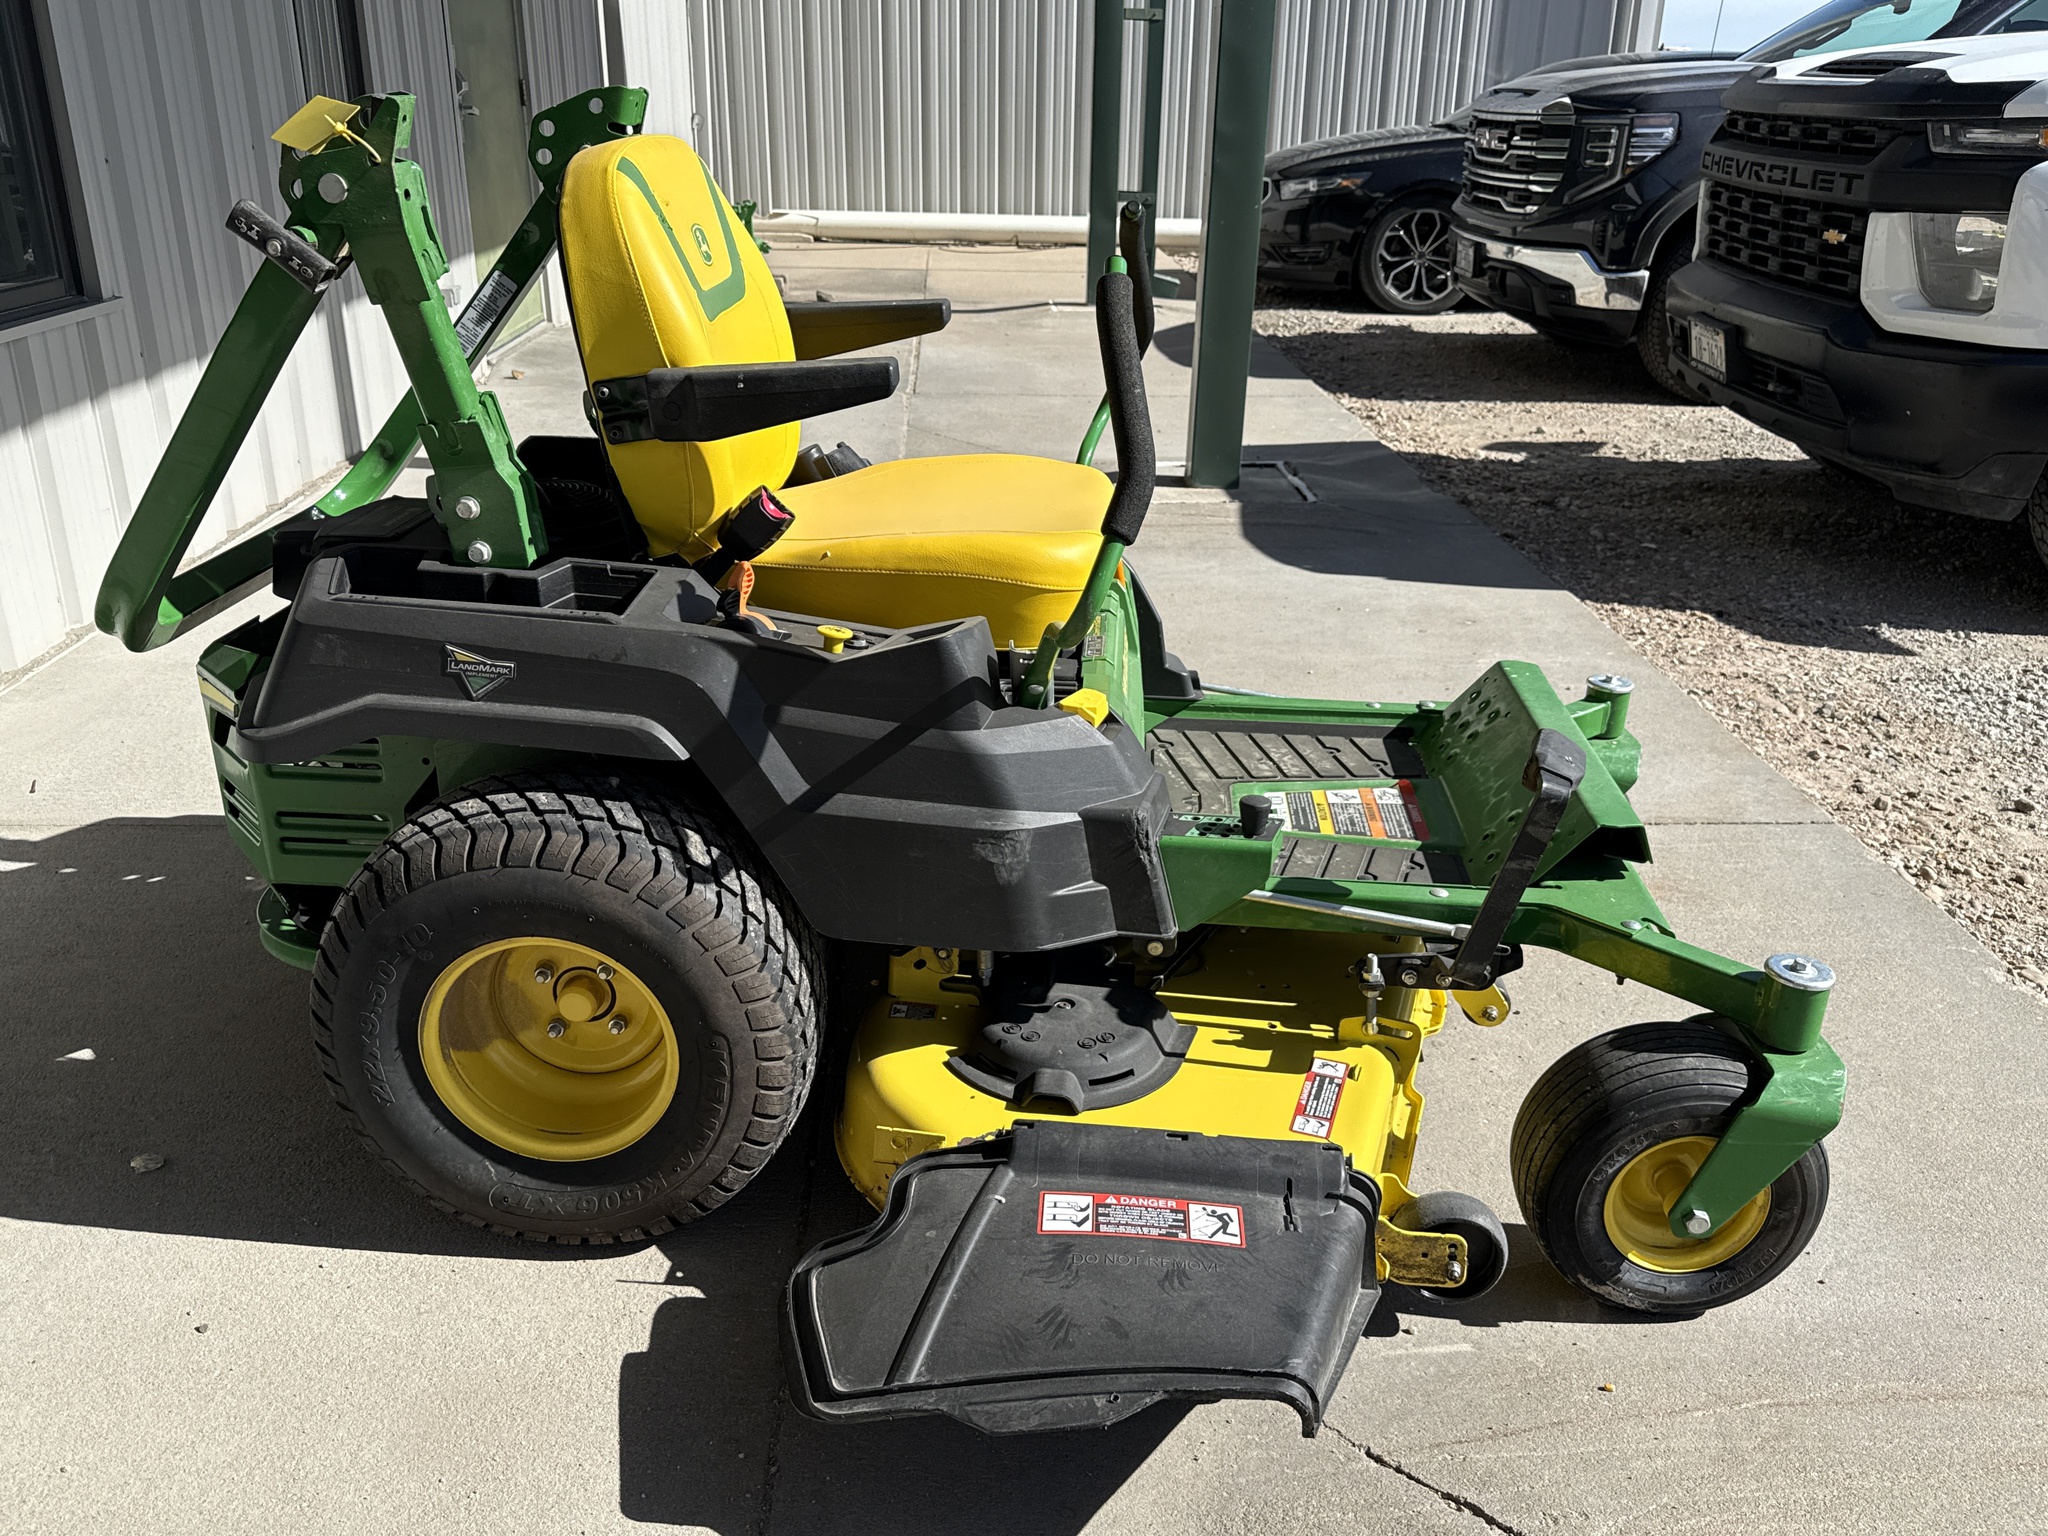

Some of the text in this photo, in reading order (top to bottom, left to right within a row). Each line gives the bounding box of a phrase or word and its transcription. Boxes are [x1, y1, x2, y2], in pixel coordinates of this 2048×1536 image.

[1702, 151, 1865, 196] CHEVROLET
[465, 671, 498, 679] IMPLEMENT
[1120, 1196, 1177, 1209] DANGER
[1072, 1253, 1227, 1274] DO NOT REMOVE
